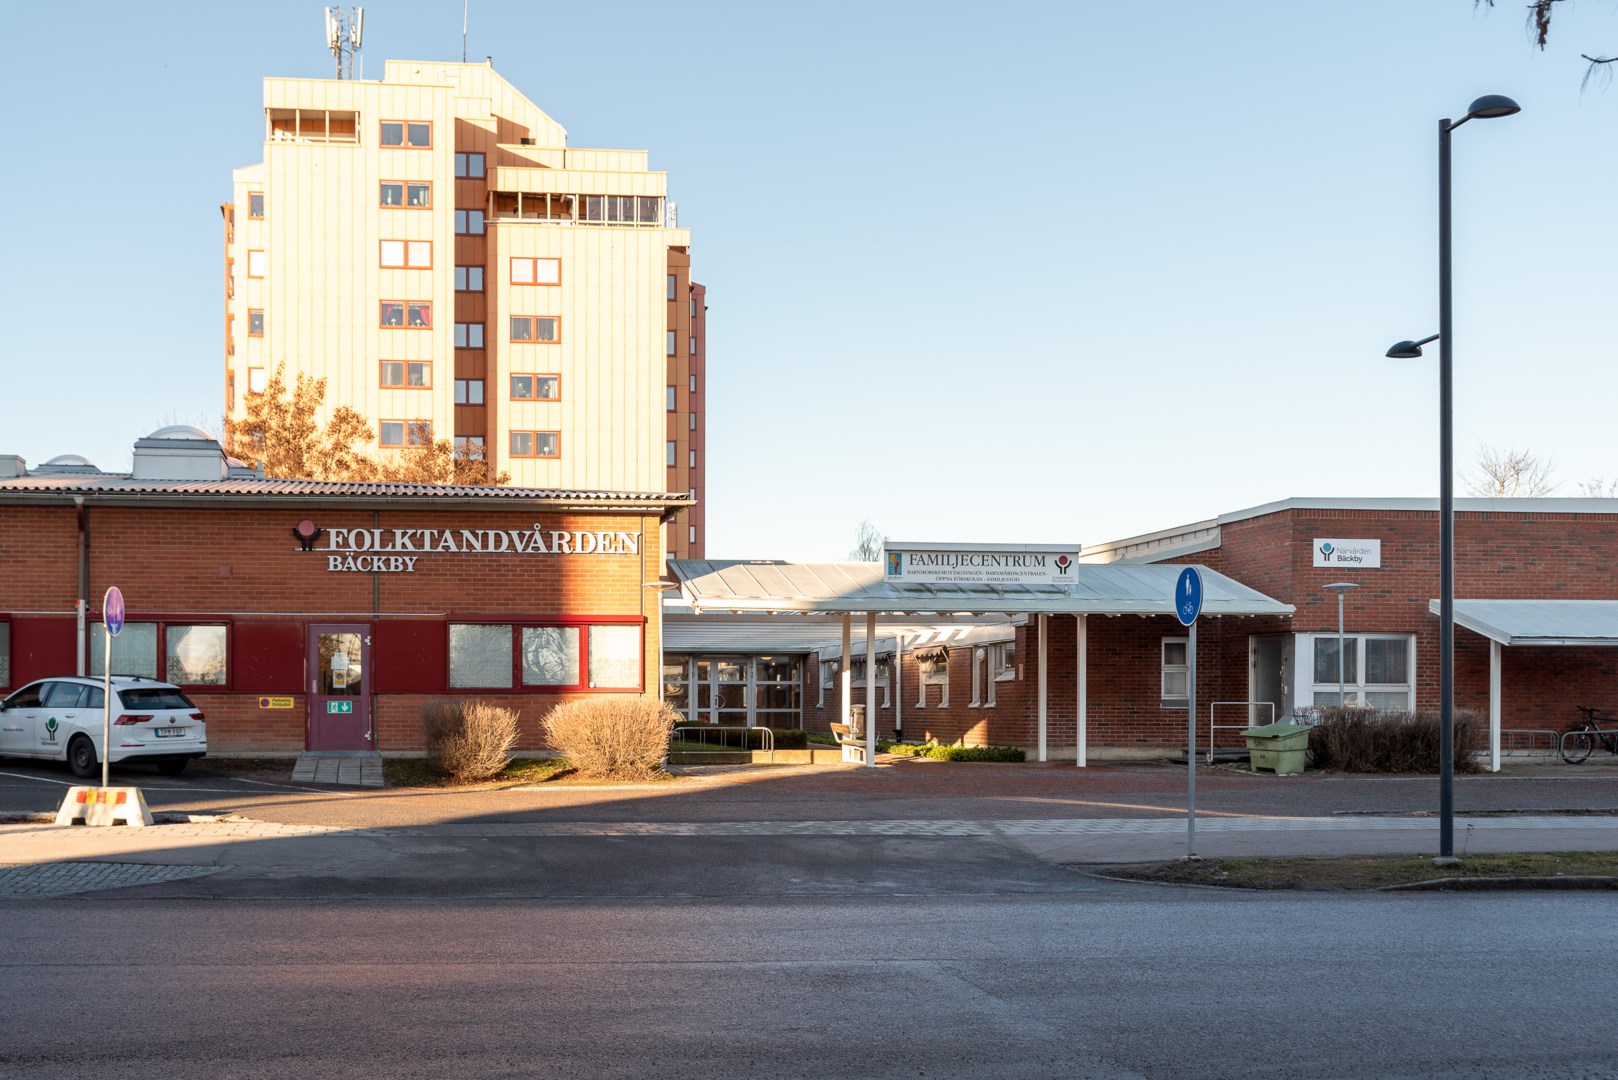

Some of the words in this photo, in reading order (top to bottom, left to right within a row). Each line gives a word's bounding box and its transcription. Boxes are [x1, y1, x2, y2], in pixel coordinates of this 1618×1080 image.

[326, 523, 642, 554] FOLKTANDVÅRDEN
[327, 552, 418, 572] BÄCKBY
[909, 553, 1046, 569] FAMILJECENTRUM
[1337, 555, 1363, 564] Bäckby
[986, 569, 1046, 577] BARNAVÅRDSCENTRALEN
